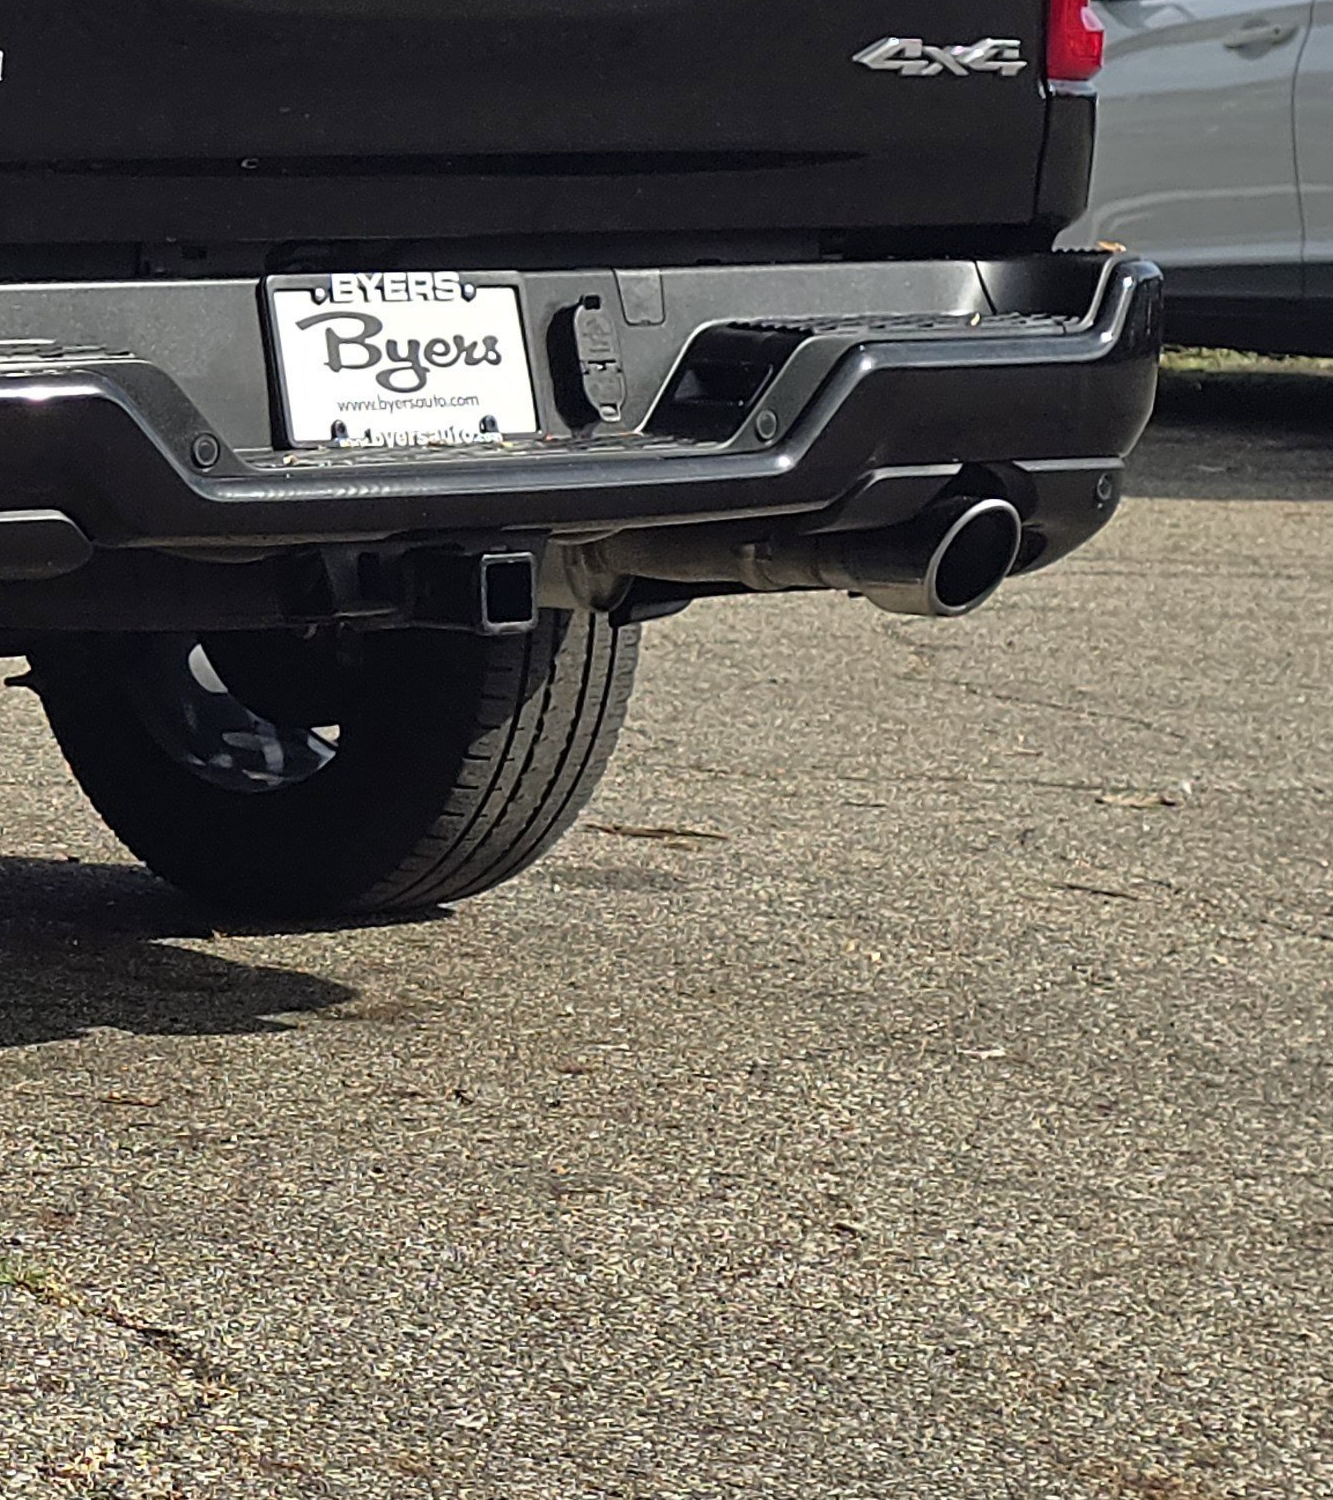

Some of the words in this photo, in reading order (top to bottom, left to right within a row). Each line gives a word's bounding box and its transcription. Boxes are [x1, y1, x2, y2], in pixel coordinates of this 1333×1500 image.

[329, 271, 461, 303] BYERS
[295, 311, 502, 393] Byers
[337, 395, 480, 414] www.byersauto.com
